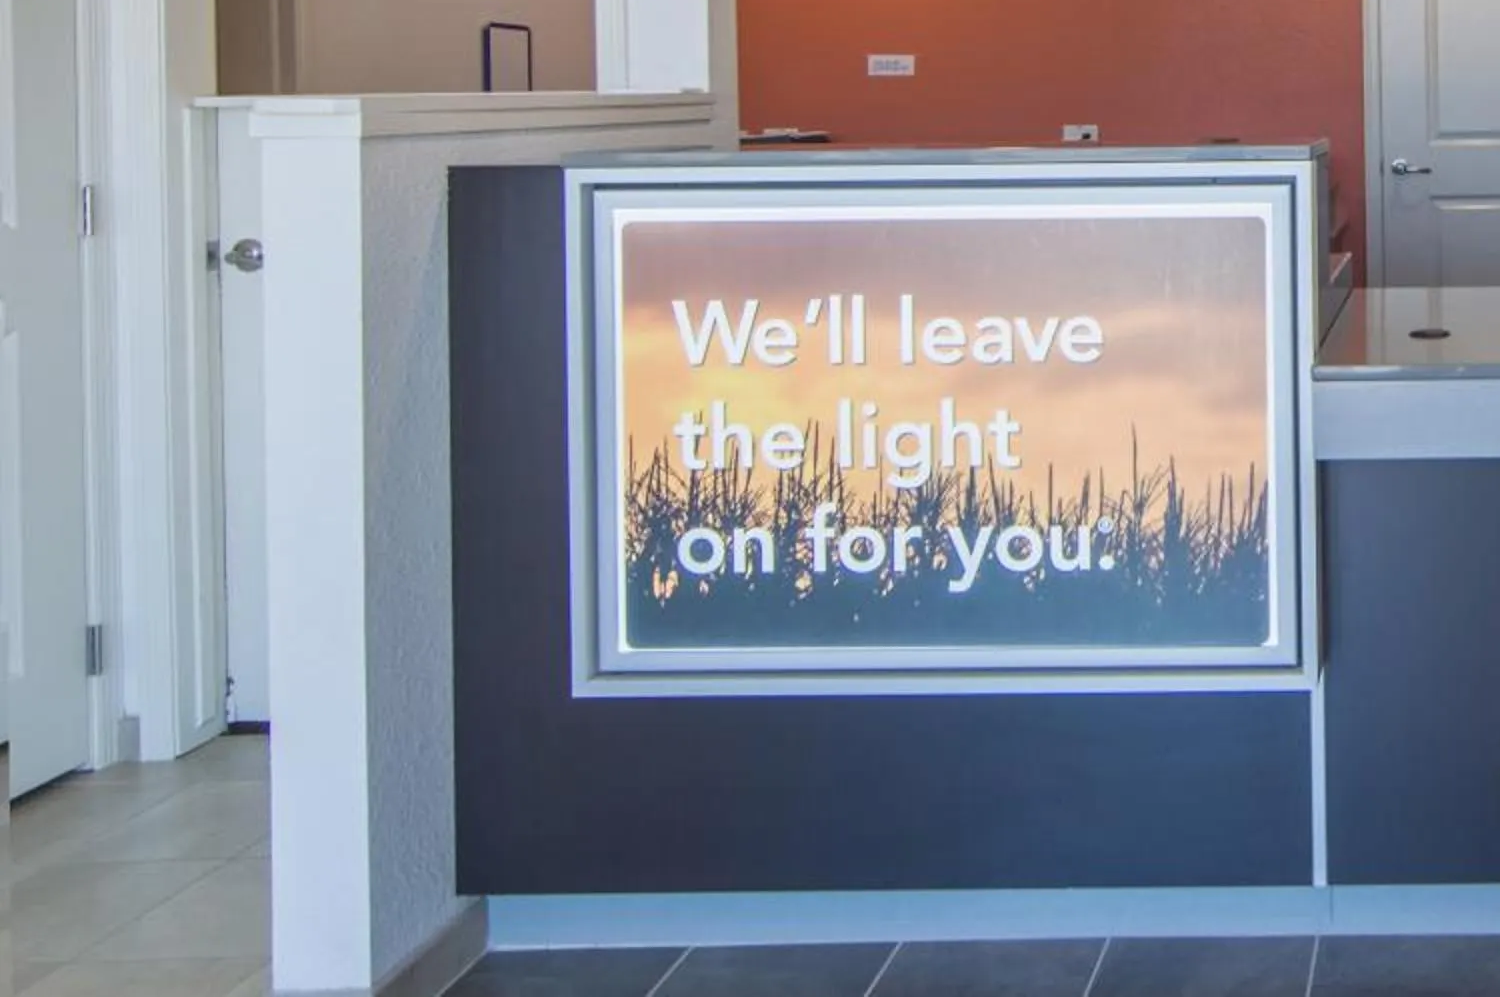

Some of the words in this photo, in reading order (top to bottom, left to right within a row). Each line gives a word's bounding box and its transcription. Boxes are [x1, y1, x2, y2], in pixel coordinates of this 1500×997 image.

[672, 294, 866, 367] We'll
[899, 294, 1104, 365] leave
[672, 400, 805, 471] the
[838, 398, 1023, 489] light
[676, 523, 774, 575] on
[808, 500, 923, 573] for
